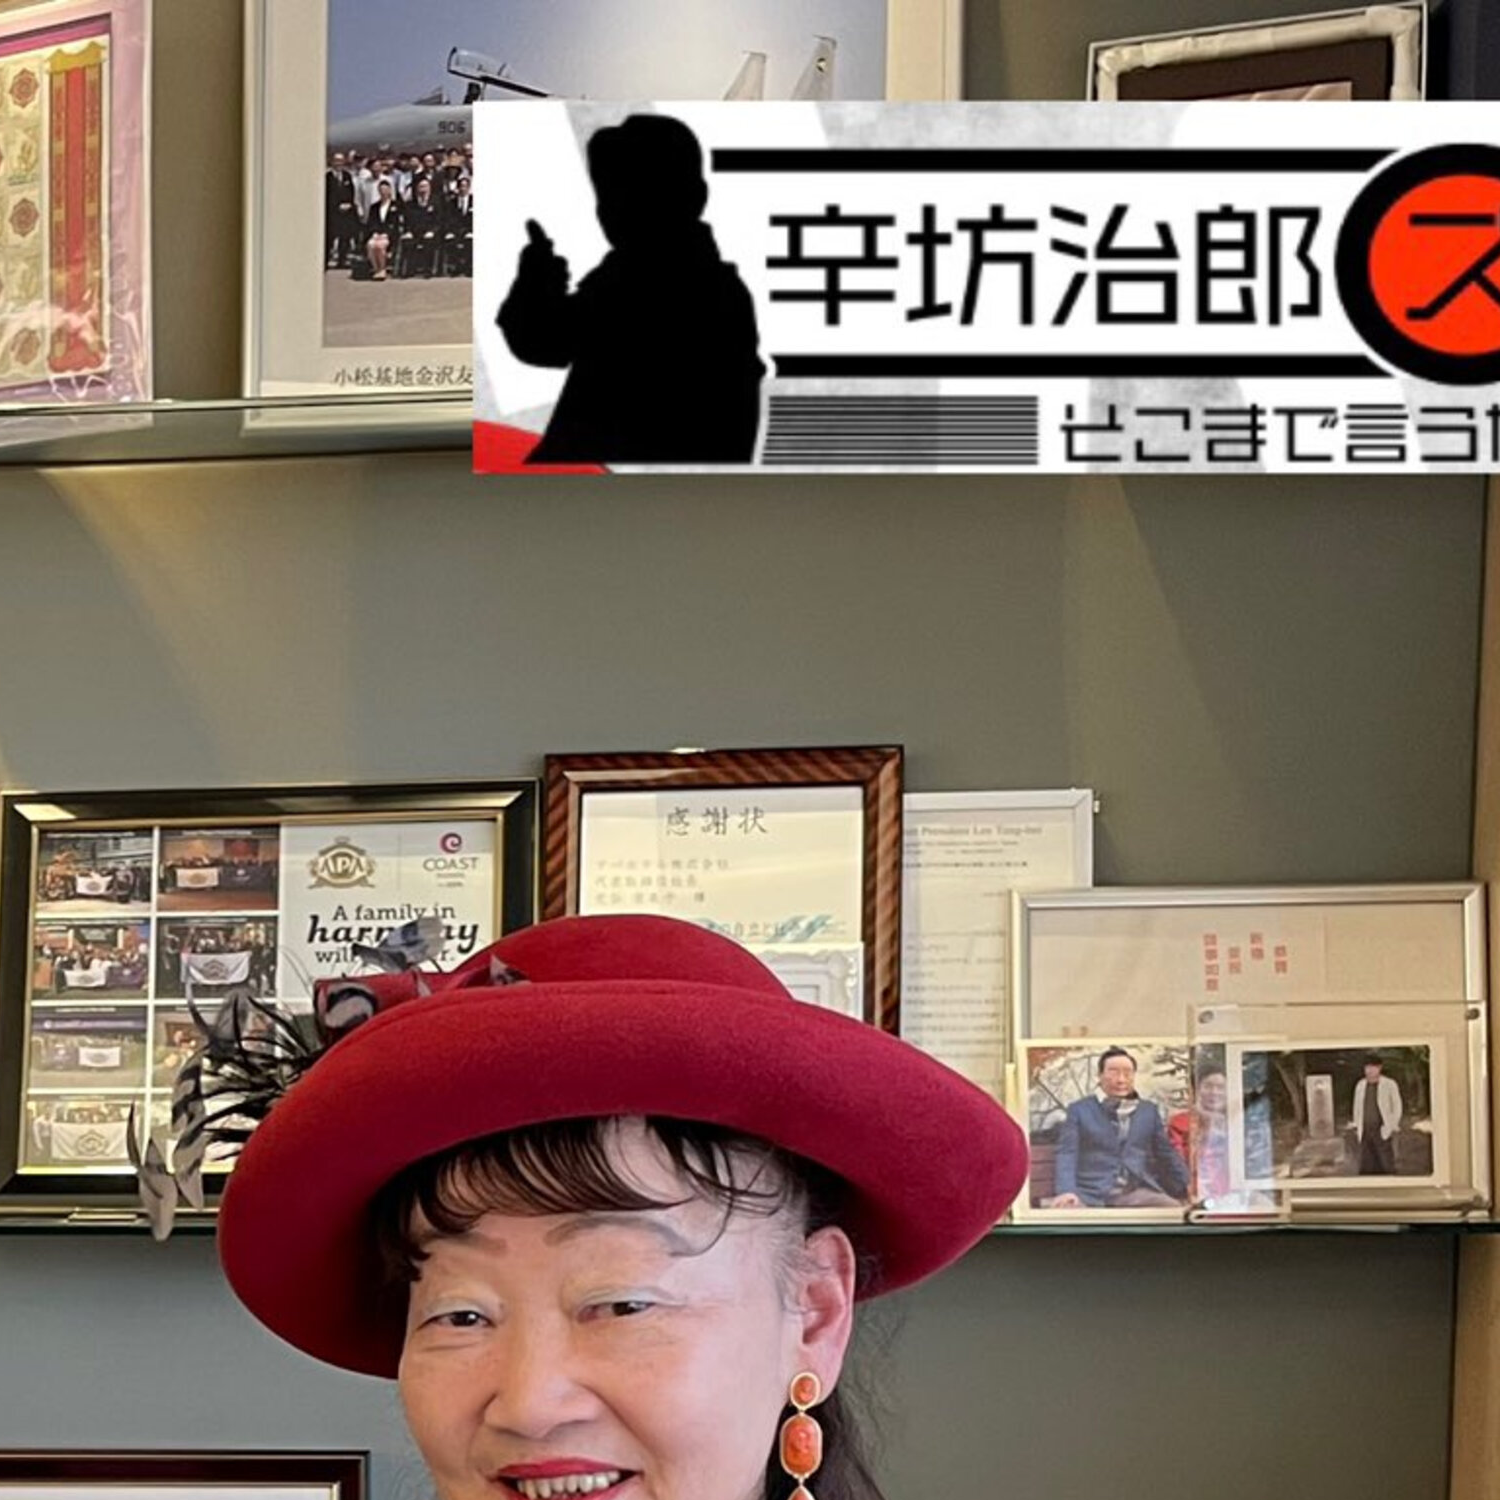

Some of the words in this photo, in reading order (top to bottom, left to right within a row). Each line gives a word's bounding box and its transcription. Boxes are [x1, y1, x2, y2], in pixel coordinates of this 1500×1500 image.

[665, 805, 769, 837] 感謝状
[422, 857, 480, 872] COAST
[332, 905, 349, 921] A
[355, 903, 428, 922] family
[434, 902, 457, 919] in
